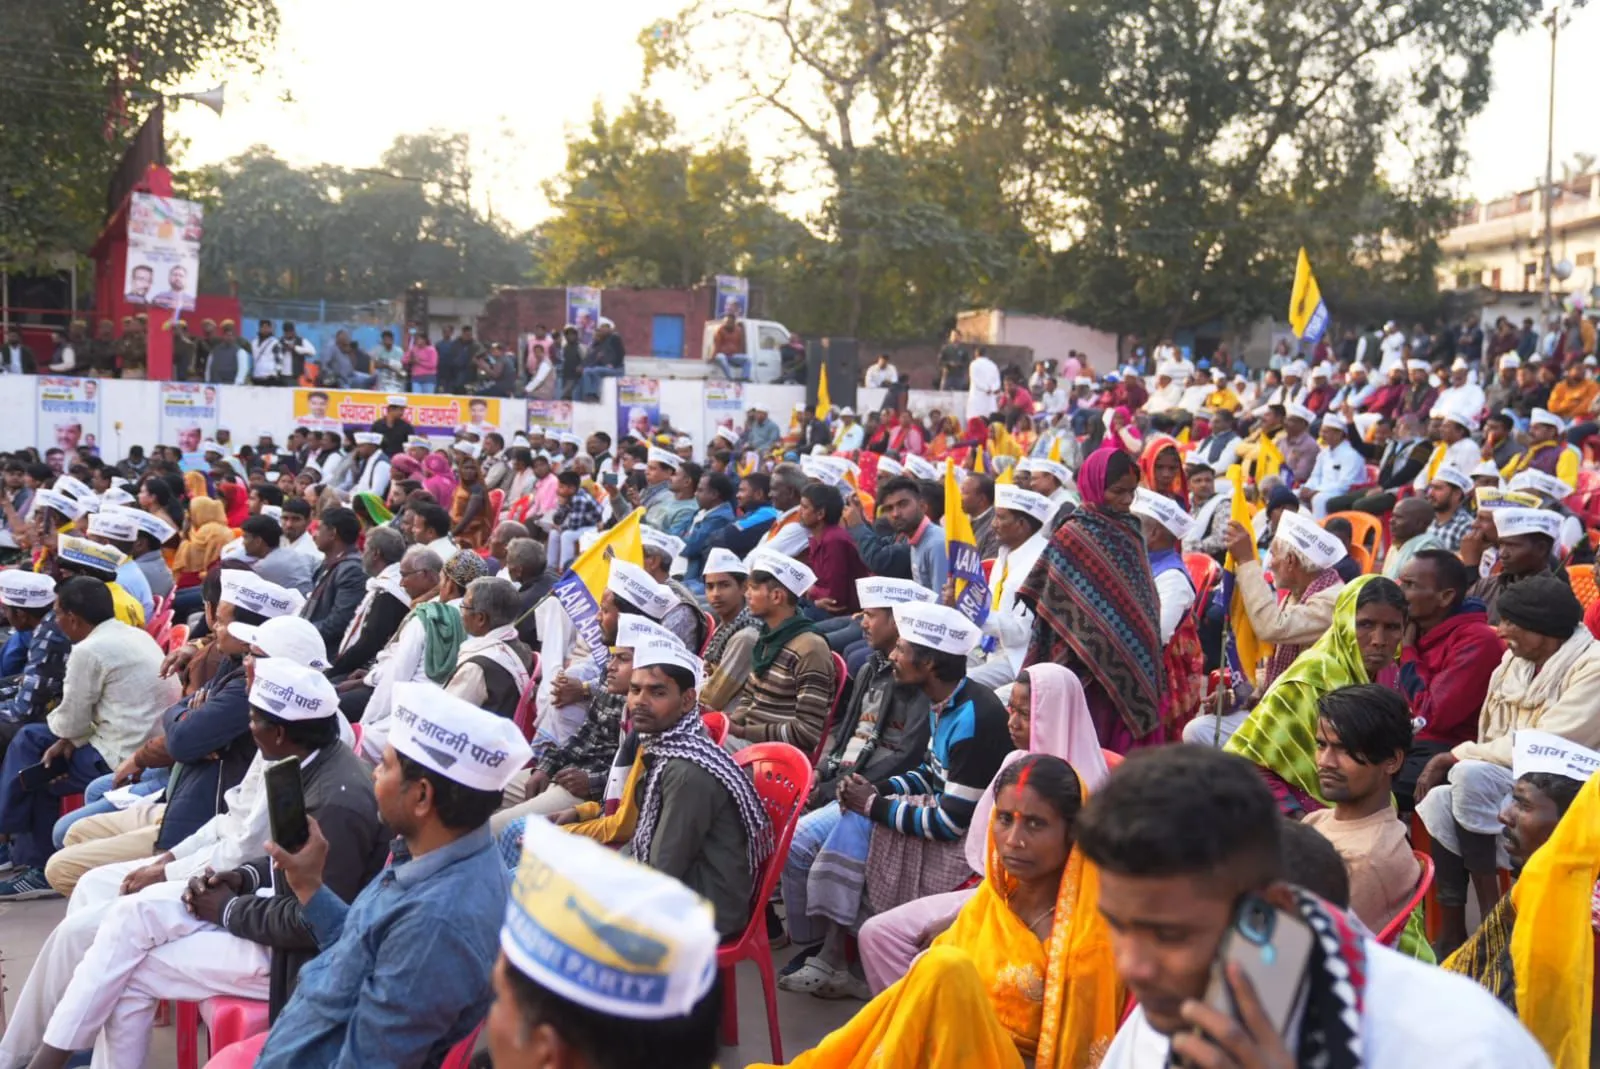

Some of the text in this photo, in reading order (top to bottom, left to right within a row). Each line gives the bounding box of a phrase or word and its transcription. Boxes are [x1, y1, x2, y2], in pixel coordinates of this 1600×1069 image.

[239, 586, 269, 605] आदमी
[554, 581, 592, 620] AAM
[885, 585, 914, 599] आदमी
[915, 619, 947, 636] आदमी
[948, 629, 969, 641] पार्टी
[261, 679, 295, 702] आदमी
[294, 693, 322, 712] पार्टी
[417, 718, 470, 755] आदमी
[469, 743, 509, 769] पार्टी
[1526, 743, 1569, 759] आम
[564, 952, 656, 1000] PARTY
